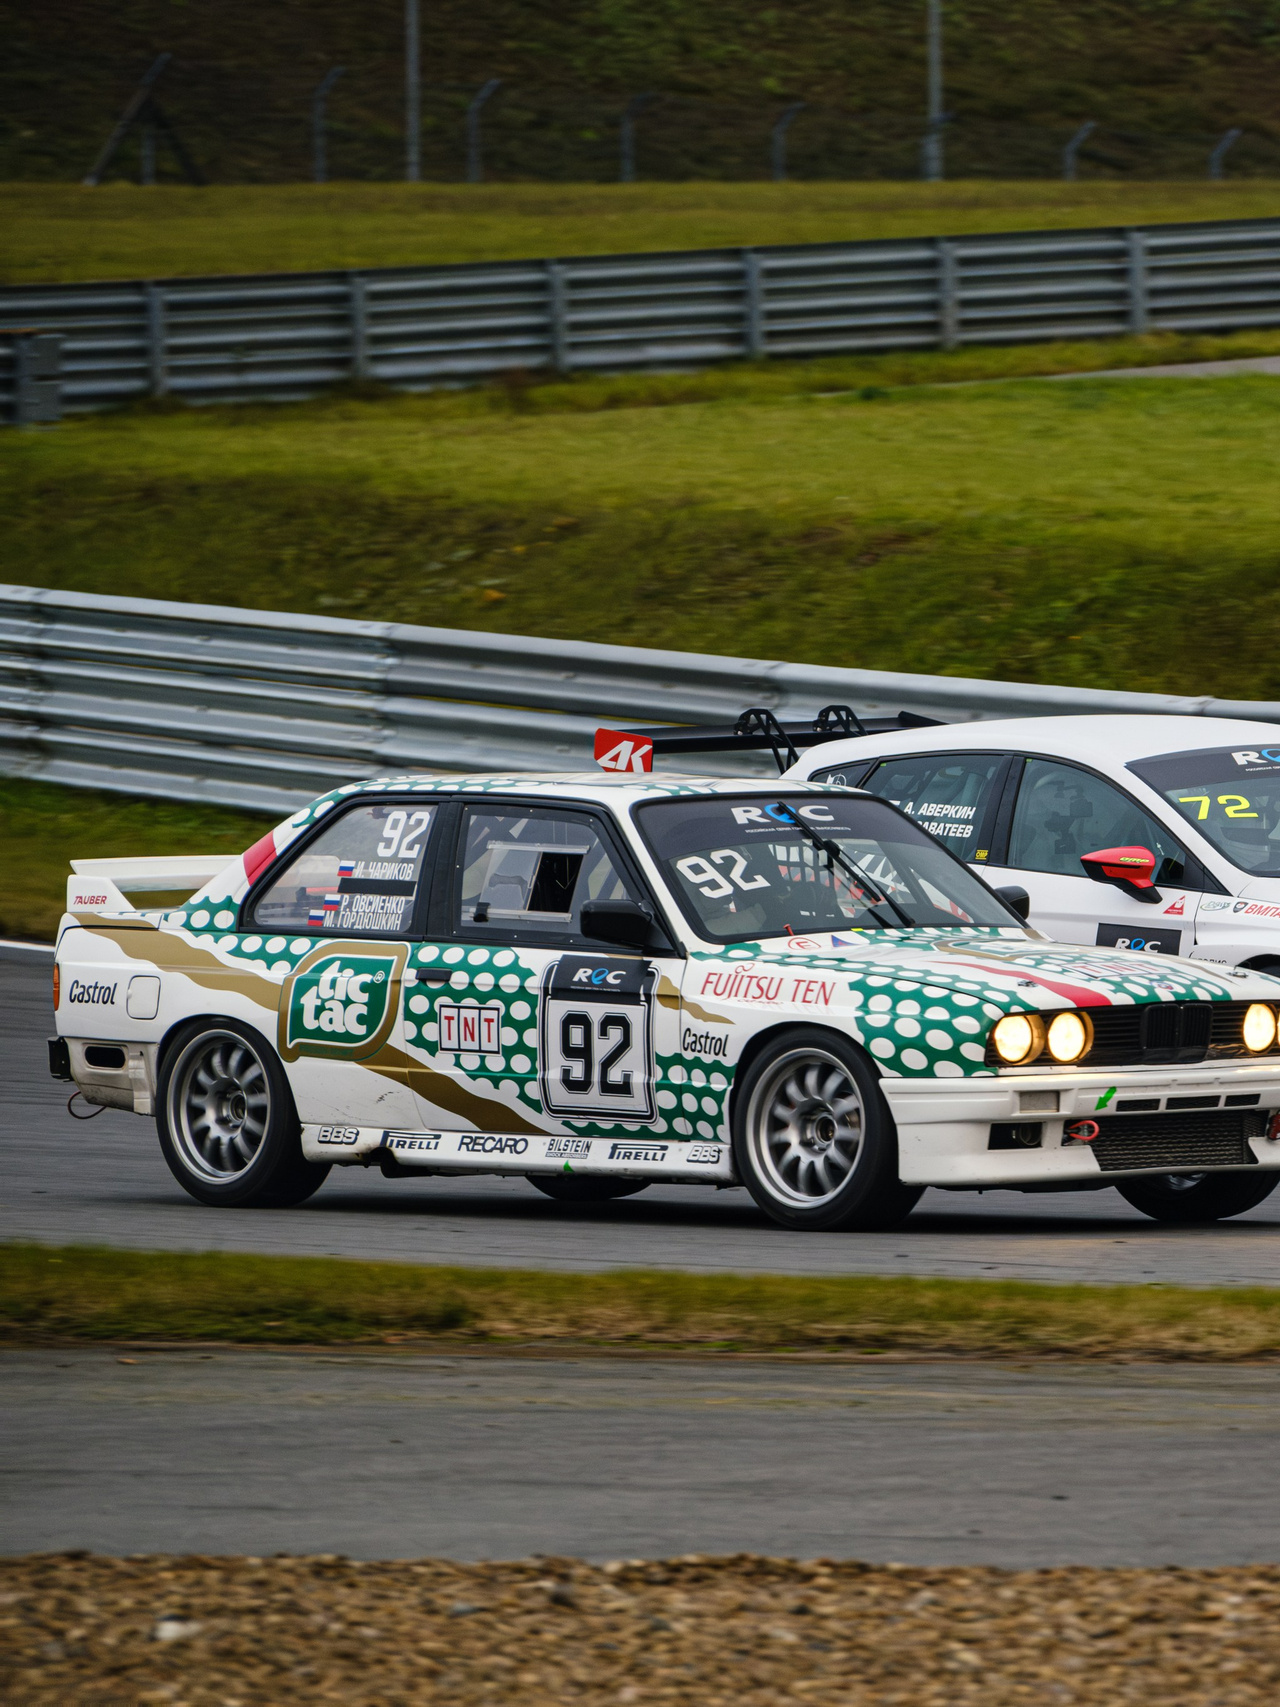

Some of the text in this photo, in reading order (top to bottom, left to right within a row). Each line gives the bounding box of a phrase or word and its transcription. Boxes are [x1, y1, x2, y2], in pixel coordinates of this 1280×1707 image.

[904, 802, 977, 819] А. АВЕРКИН
[1178, 794, 1259, 820] 72
[377, 811, 431, 859] 92
[917, 821, 973, 838] АВАТЕЕВ
[368, 861, 414, 880] ЧАРИКОВ
[675, 848, 771, 899] 92
[73, 896, 107, 905] TAUBER
[340, 895, 406, 913] Р. ОВСИЕНКО
[323, 911, 403, 931] М. ГОРДЮШКИН
[319, 960, 374, 1003] tic
[699, 963, 837, 1006] FUJITSU TEN
[69, 979, 118, 1005] Castrol
[300, 986, 368, 1036] tac
[443, 1014, 495, 1044] TNT
[682, 1027, 729, 1058] Castrol
[559, 1009, 635, 1098] 92
[317, 1126, 360, 1145] BBS
[380, 1130, 442, 1150] PIRELLI
[457, 1135, 529, 1155] RECARO
[547, 1138, 592, 1153] BILSTEIN
[608, 1142, 669, 1162] PIRELLI
[686, 1145, 722, 1164] BBS
